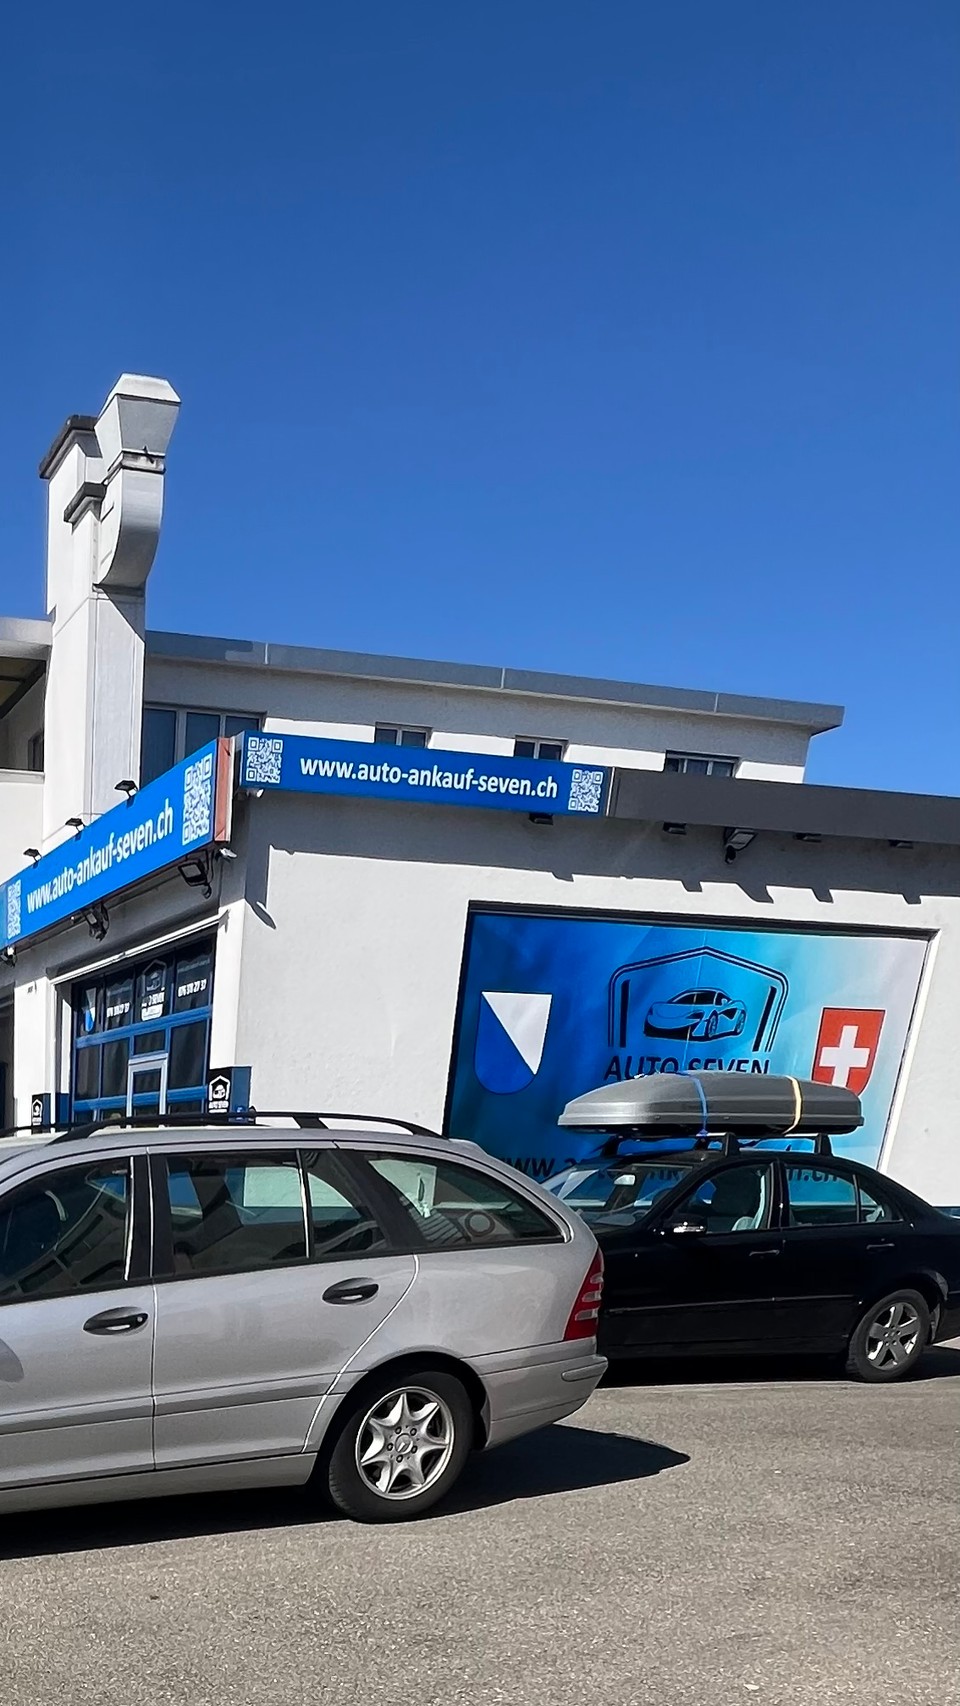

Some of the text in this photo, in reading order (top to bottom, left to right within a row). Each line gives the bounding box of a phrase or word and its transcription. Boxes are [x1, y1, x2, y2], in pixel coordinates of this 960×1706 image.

[300, 757, 558, 798] www.auto-ankauf-seven.ch
[26, 798, 174, 914] www.auto-ankauf-seven.ch
[603, 1055, 679, 1082] AUTO
